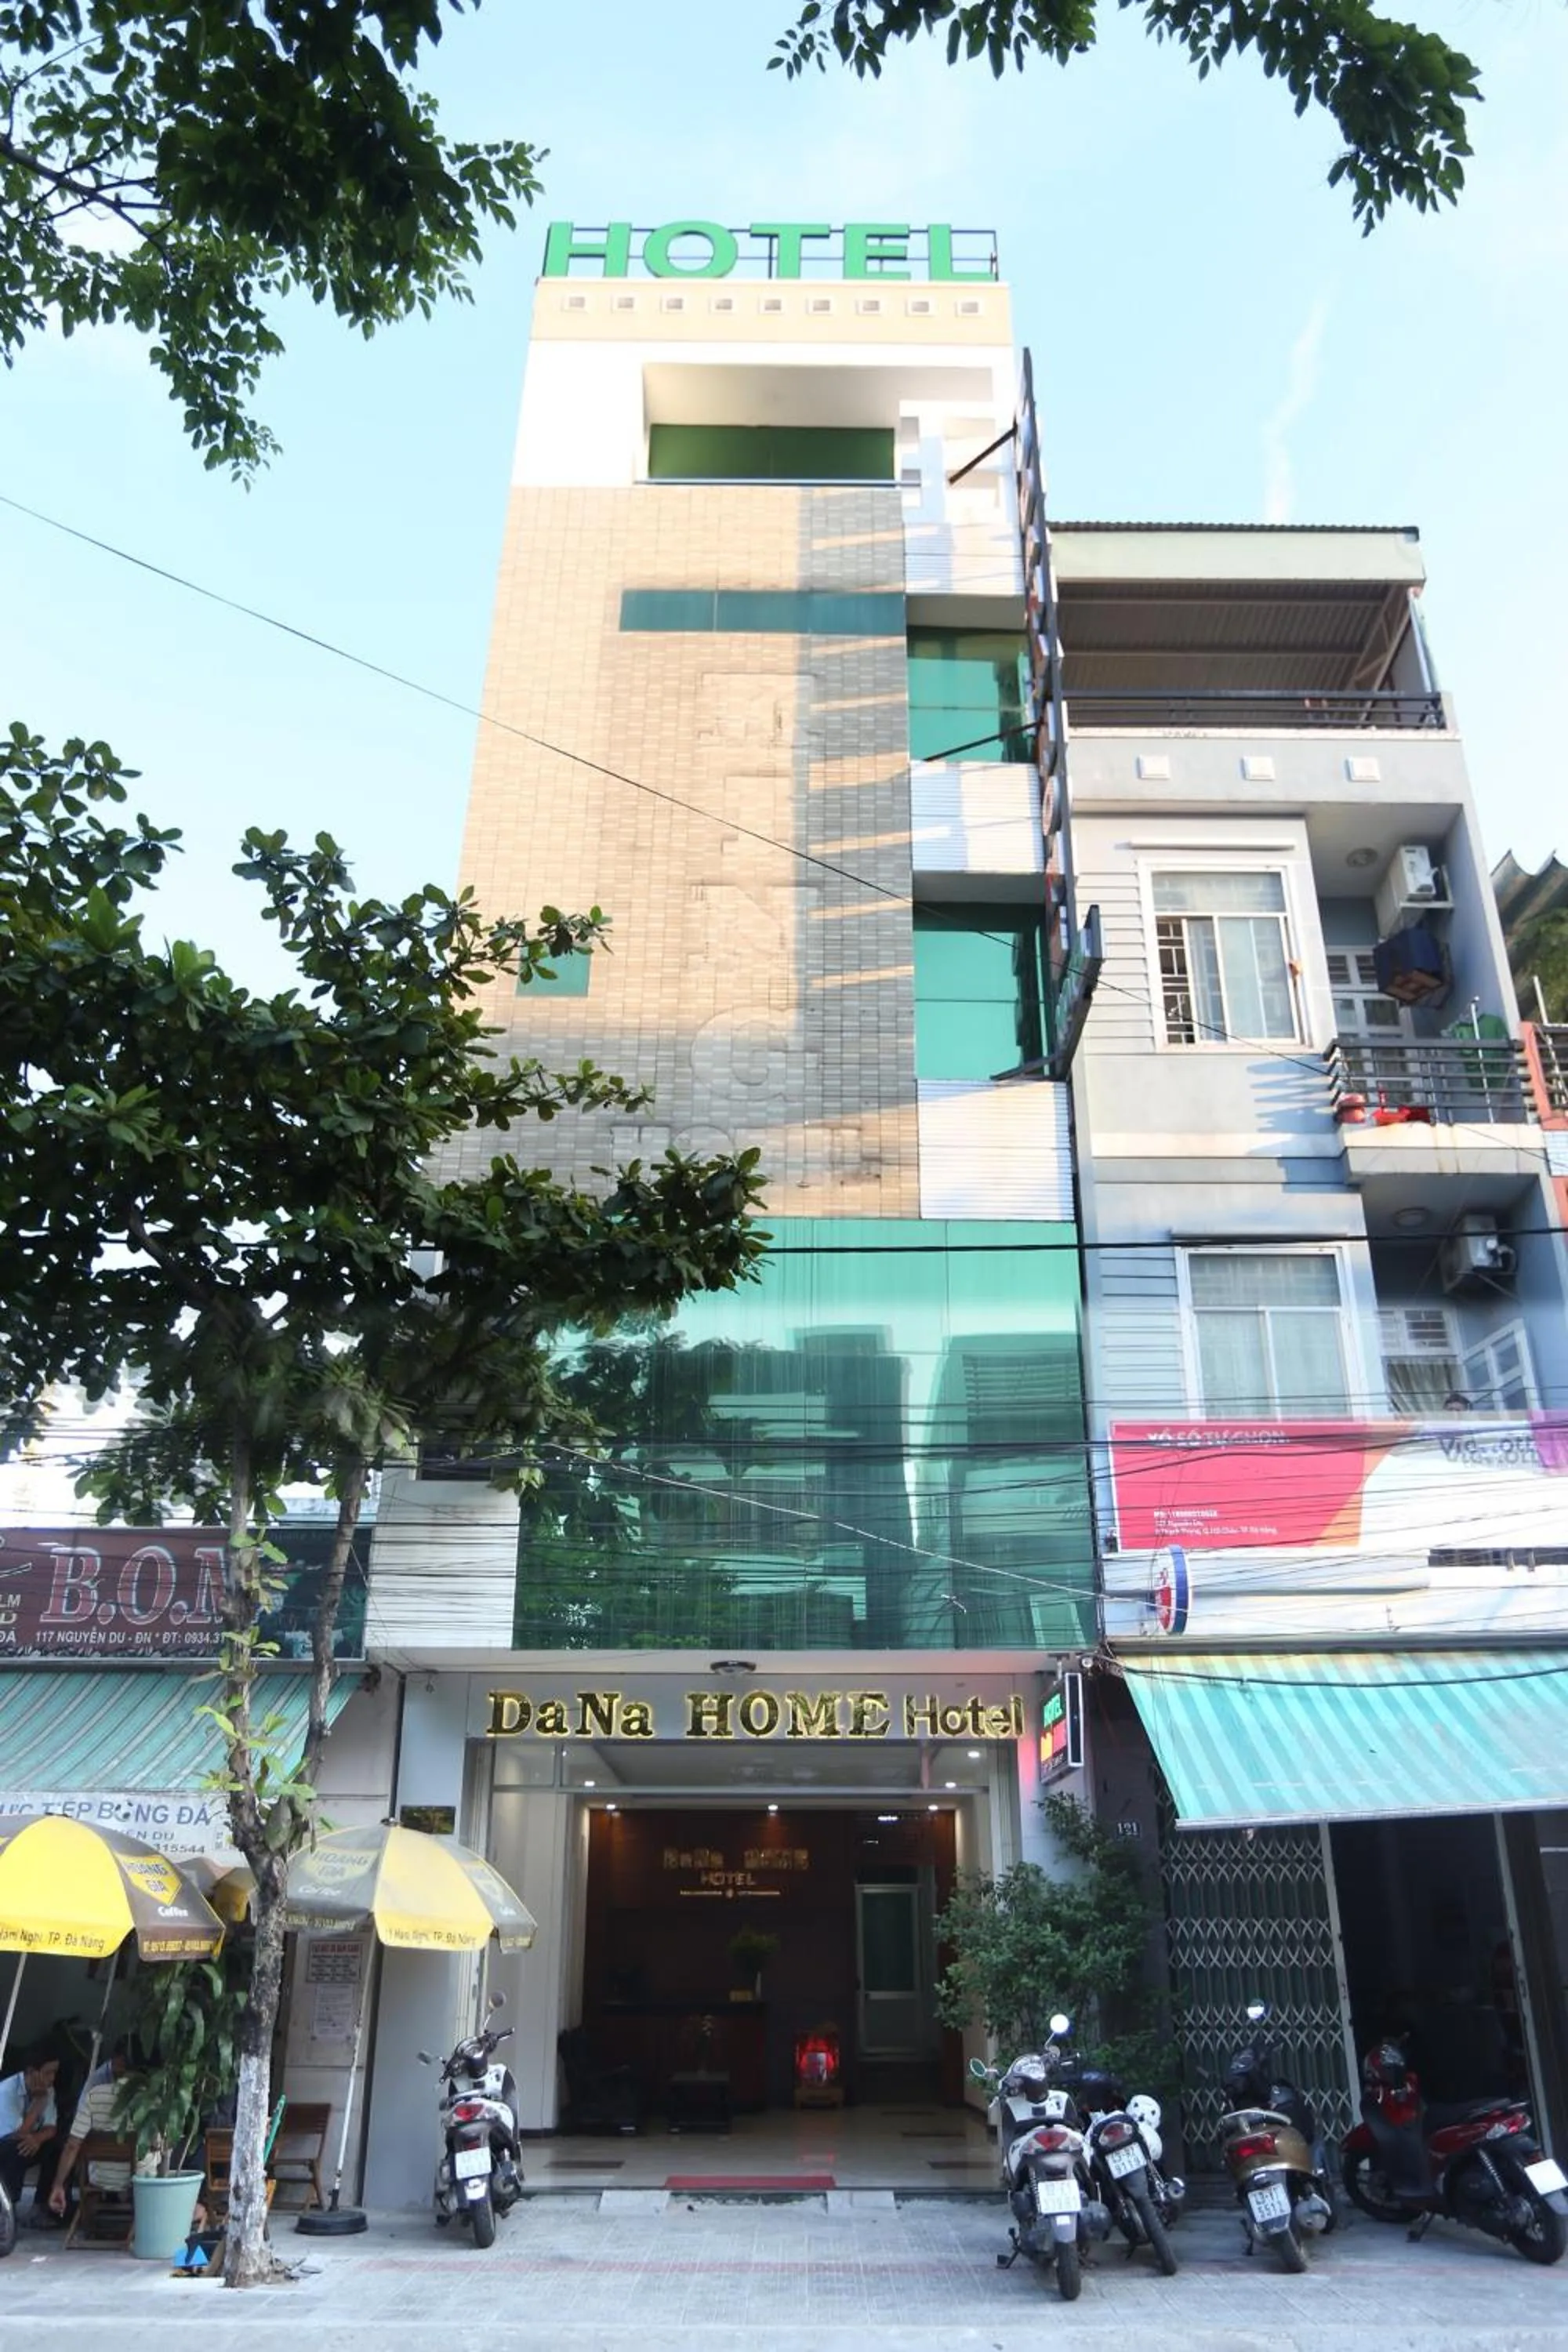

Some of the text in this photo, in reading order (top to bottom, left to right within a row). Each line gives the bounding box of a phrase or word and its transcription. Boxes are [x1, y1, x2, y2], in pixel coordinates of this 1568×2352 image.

[545, 220, 995, 281] HOTEL
[35, 1632, 53, 1643] 117
[109, 1632, 125, 1644] DU
[184, 1632, 227, 1644] 0934.31
[487, 1690, 1025, 1737] DaNa HOME Hotel
[151, 1831, 175, 1841] DU
[700, 1871, 756, 1886] HOTEL
